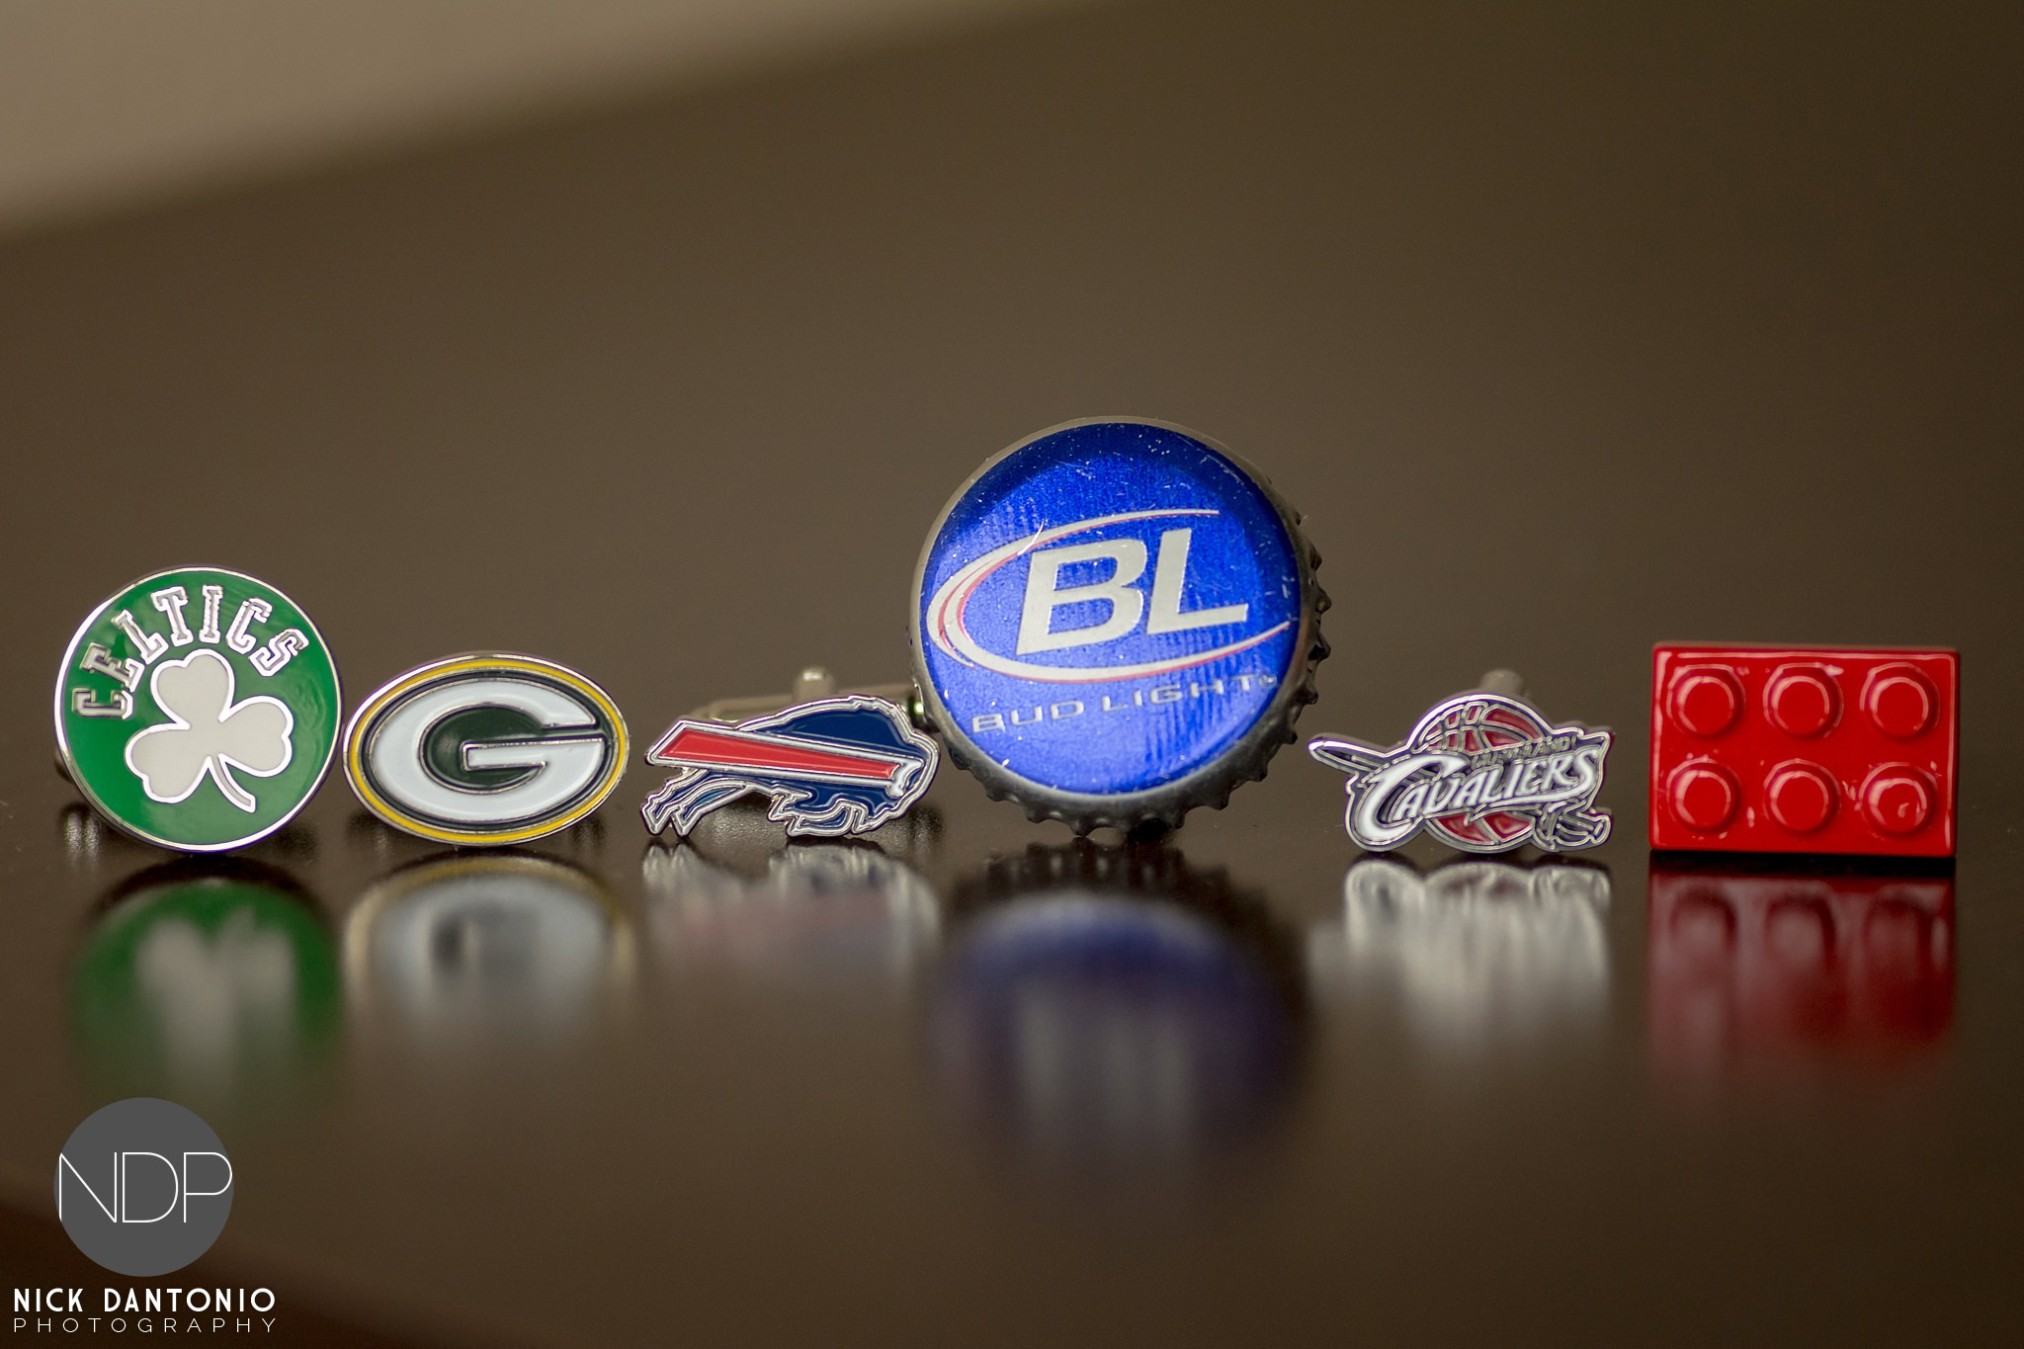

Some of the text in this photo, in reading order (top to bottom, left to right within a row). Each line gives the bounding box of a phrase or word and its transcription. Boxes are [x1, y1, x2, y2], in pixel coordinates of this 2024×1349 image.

[71, 585, 309, 720] CELTICS
[1016, 528, 1249, 656] BL
[370, 678, 602, 821] G
[972, 675, 1255, 734] BUD LIGHT
